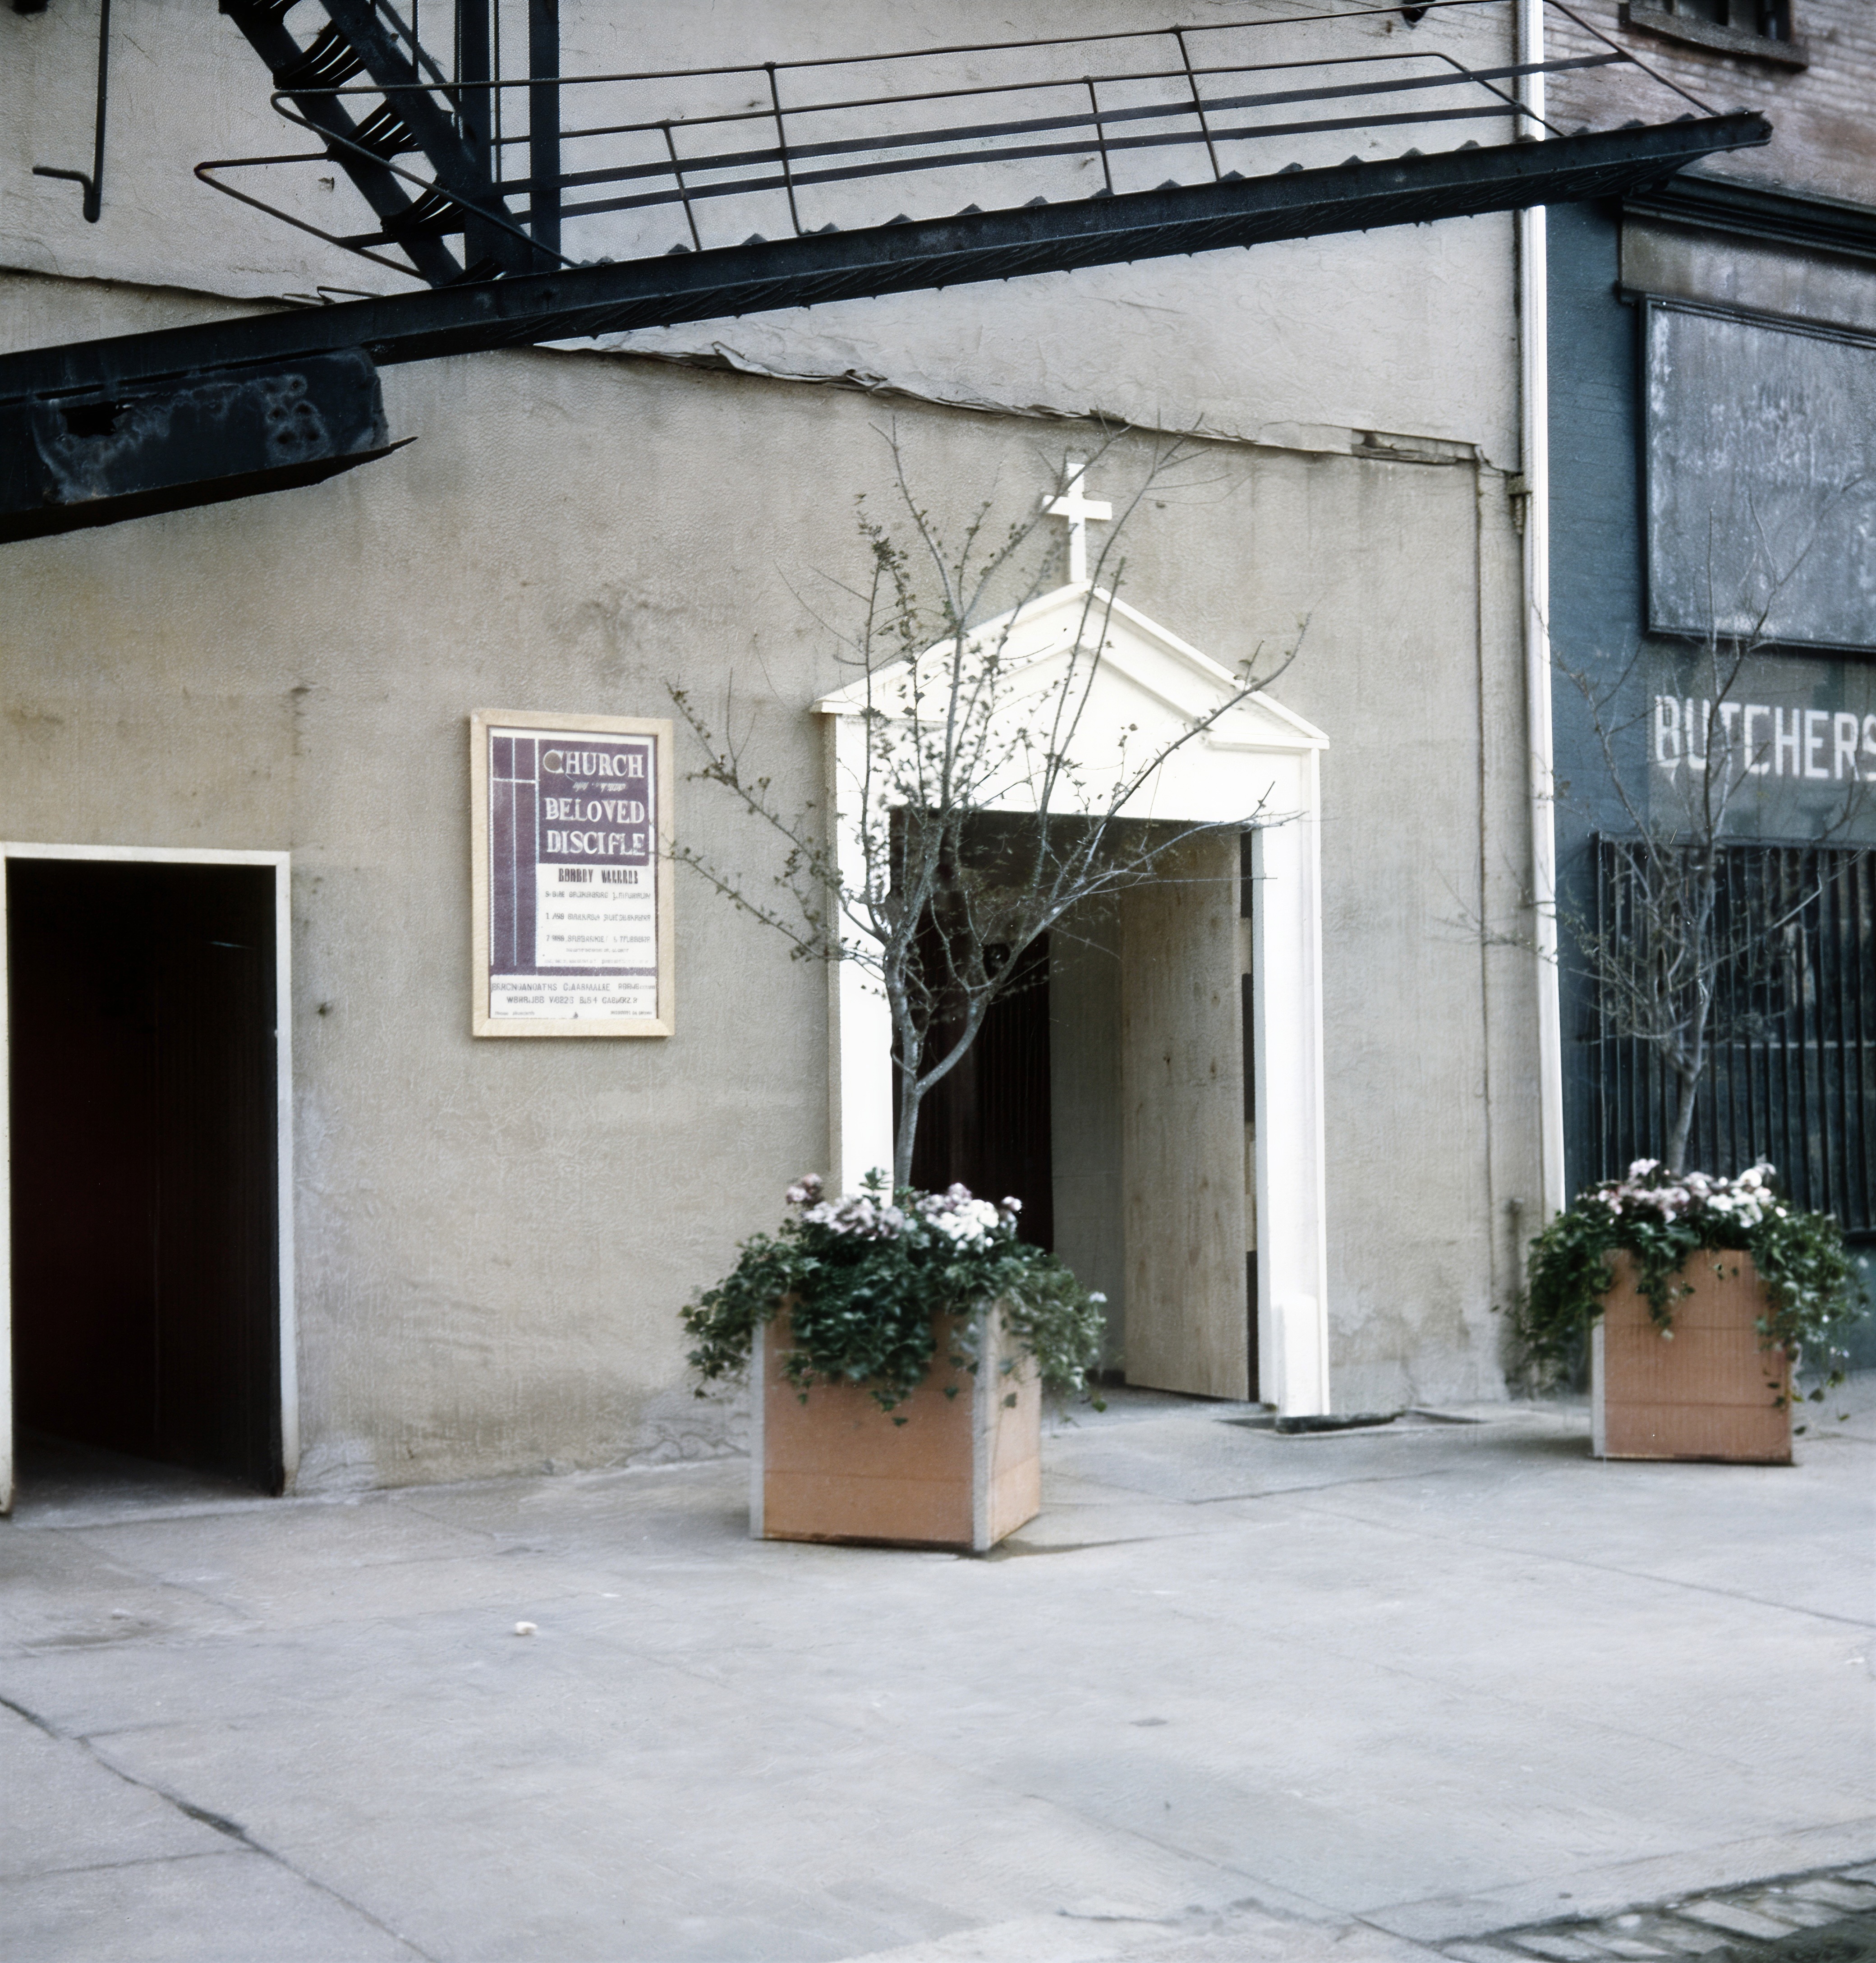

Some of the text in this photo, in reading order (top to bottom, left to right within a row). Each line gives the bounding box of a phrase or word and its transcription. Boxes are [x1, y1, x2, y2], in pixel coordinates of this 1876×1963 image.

[1654, 695, 1876, 782] BUTCHERS
[543, 749, 644, 778] CHURCH
[544, 797, 645, 824] BELOVED
